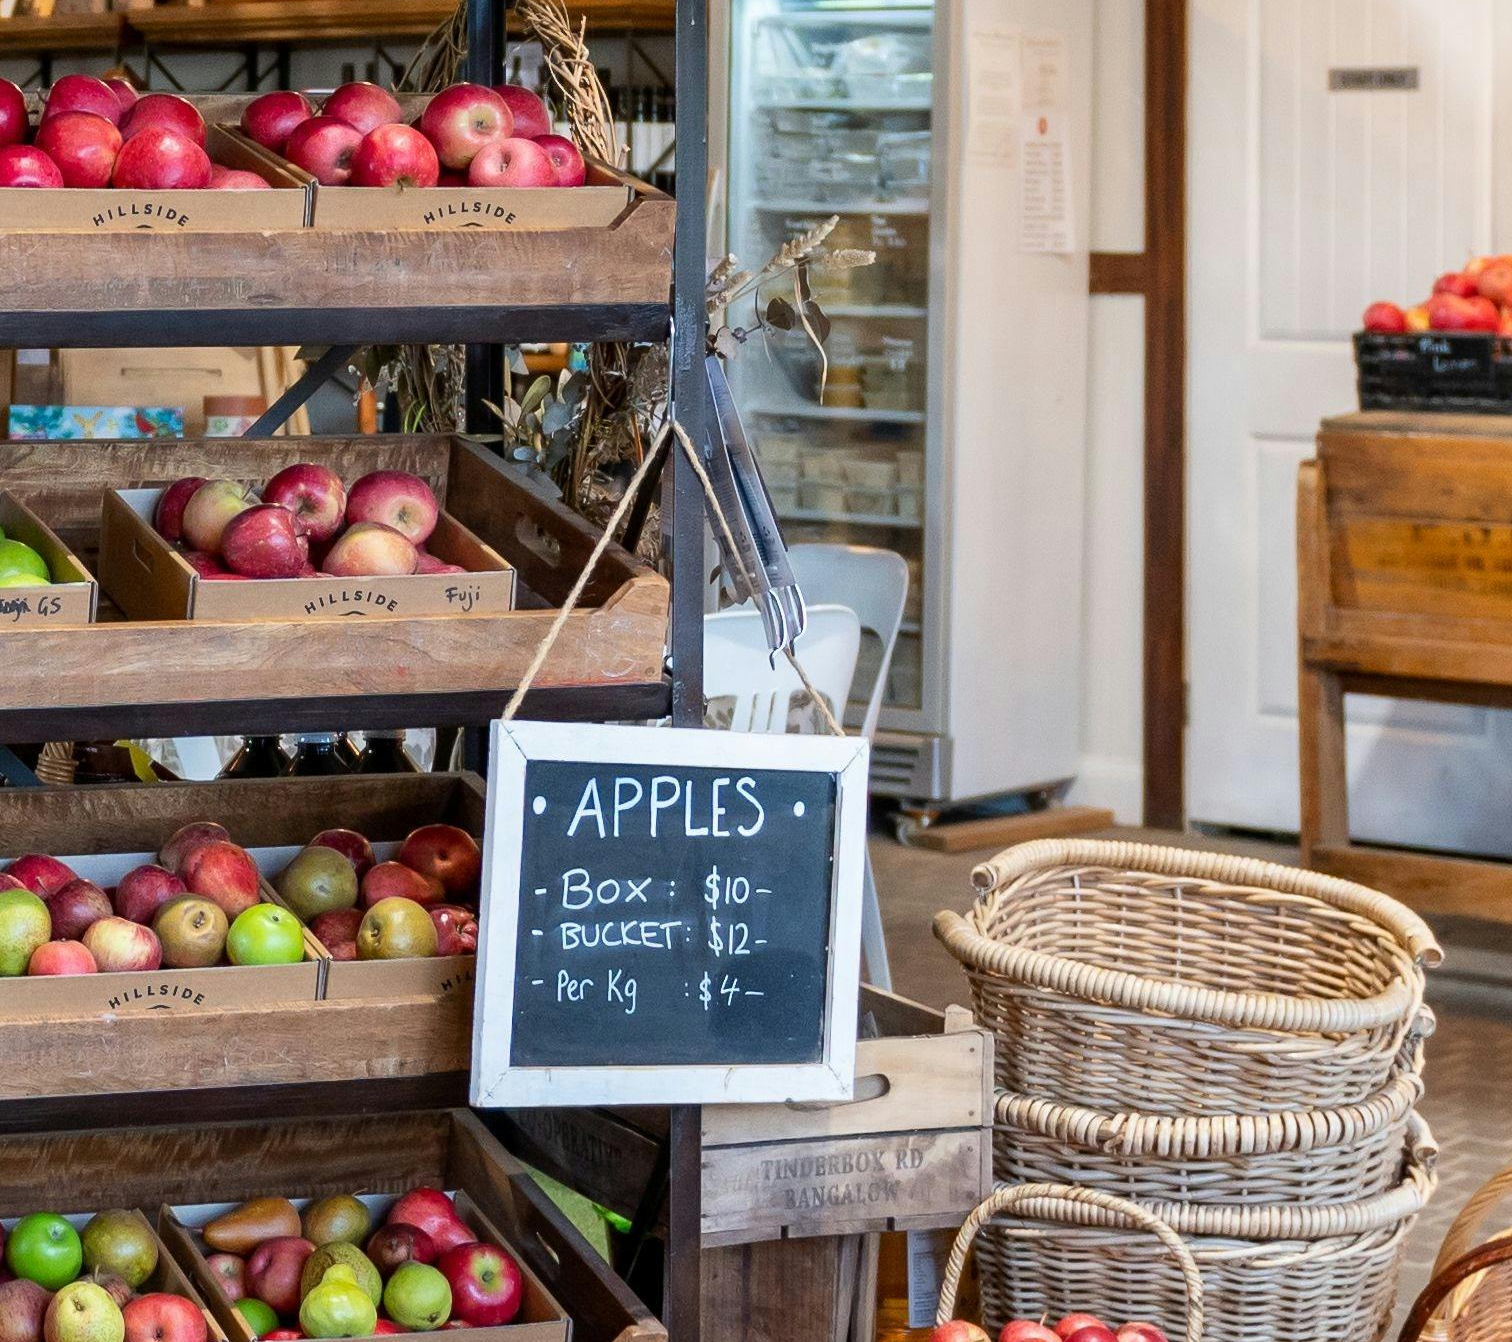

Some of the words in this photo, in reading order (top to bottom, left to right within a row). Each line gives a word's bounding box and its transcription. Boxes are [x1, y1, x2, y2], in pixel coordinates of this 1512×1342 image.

[92, 201, 190, 227] HILLSIDE
[423, 200, 517, 225] HILLSIDE
[304, 591, 399, 616] HILLSIDE
[446, 586, 481, 613] Fuji
[567, 776, 765, 839] APPLES
[106, 985, 207, 1010] HILLSIDE
[557, 969, 594, 1003] Per
[607, 968, 638, 1015] Kg
[760, 1147, 887, 1182] TINDERBOX
[895, 1147, 924, 1169] RD
